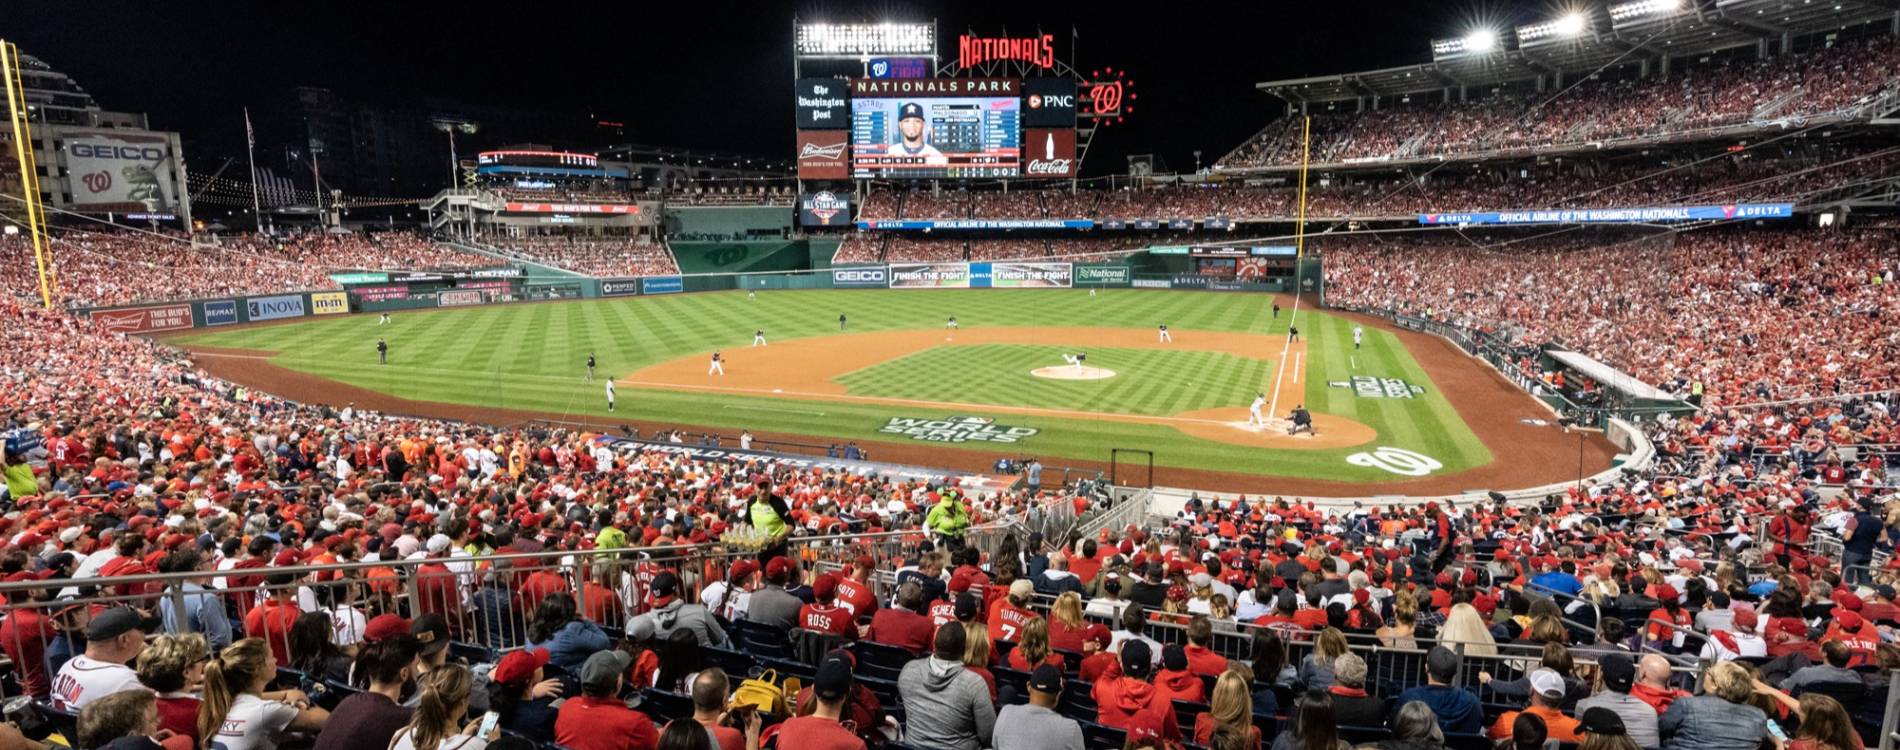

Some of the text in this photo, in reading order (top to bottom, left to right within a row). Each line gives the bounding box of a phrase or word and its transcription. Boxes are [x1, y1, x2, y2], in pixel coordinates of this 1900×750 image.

[960, 34, 1054, 69] NATIONALS
[814, 85, 828, 94] The
[858, 82, 1012, 92] NATIONALS PARK
[799, 96, 845, 107] Washington
[1044, 96, 1073, 107] PNC
[813, 110, 831, 121] Post
[71, 144, 162, 160] GEICO
[1500, 213, 1530, 222] OFFICIAL
[1532, 212, 1560, 221] AIRLINE
[1561, 212, 1570, 220] OF
[1573, 211, 1587, 220] THE
[1590, 210, 1641, 220] WASHINGTON
[836, 271, 883, 281] GEICO
[150, 308, 189, 318] THIS BUD'S
[206, 308, 234, 317] RE/MAX
[263, 300, 302, 314] INOVA
[151, 320, 166, 328] FOR
[890, 417, 1038, 437] WORLD
[880, 426, 1021, 443] SERIES
[642, 444, 725, 458] WORLD
[838, 584, 855, 598] SOTO
[807, 613, 832, 630] ROSS
[1001, 624, 1016, 640] 7
